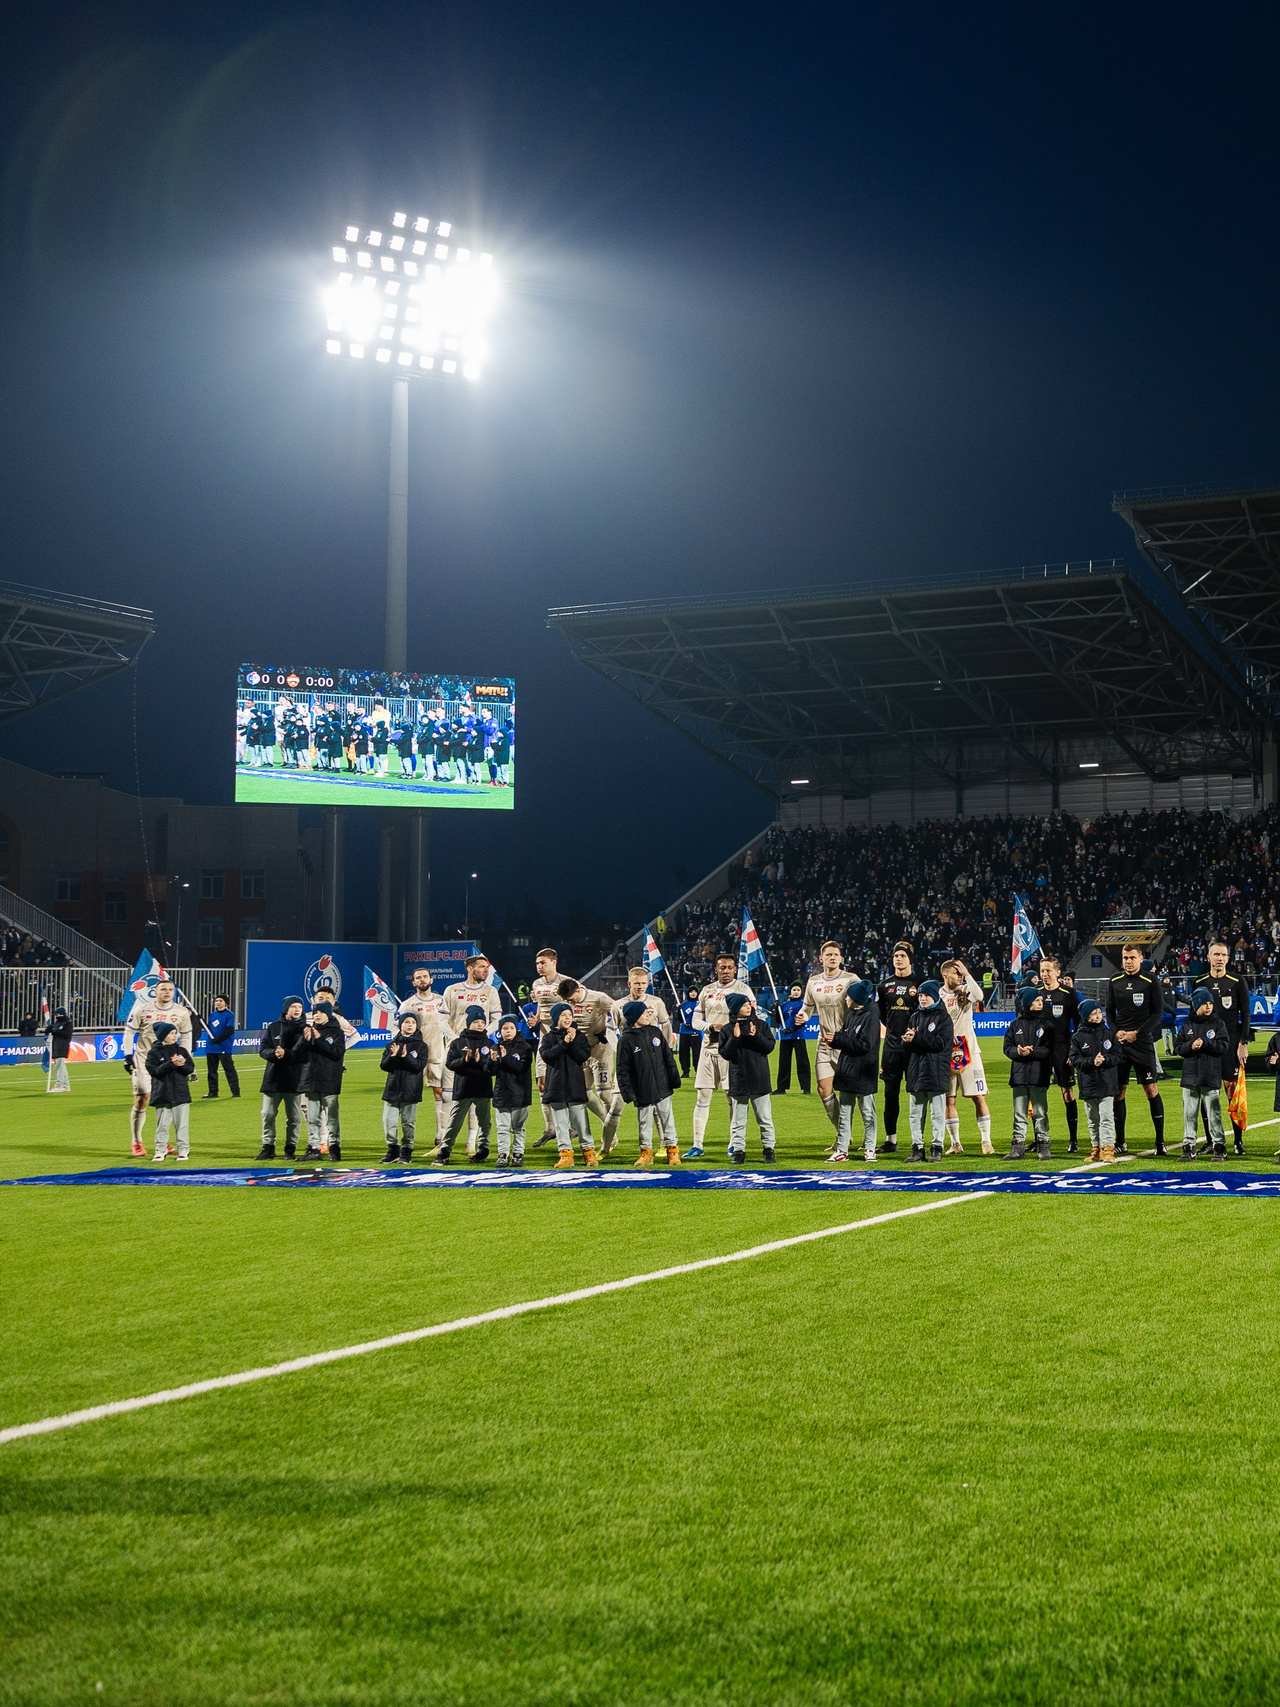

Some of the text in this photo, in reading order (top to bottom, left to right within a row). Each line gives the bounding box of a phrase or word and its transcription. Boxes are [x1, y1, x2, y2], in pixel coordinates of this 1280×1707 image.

[262, 674, 270, 684] 0
[277, 675, 285, 685] 0
[306, 676, 334, 687] 0:00
[403, 950, 468, 963] FAKELFC.RU
[599, 1072, 608, 1083] 13
[975, 1080, 984, 1092] 10
